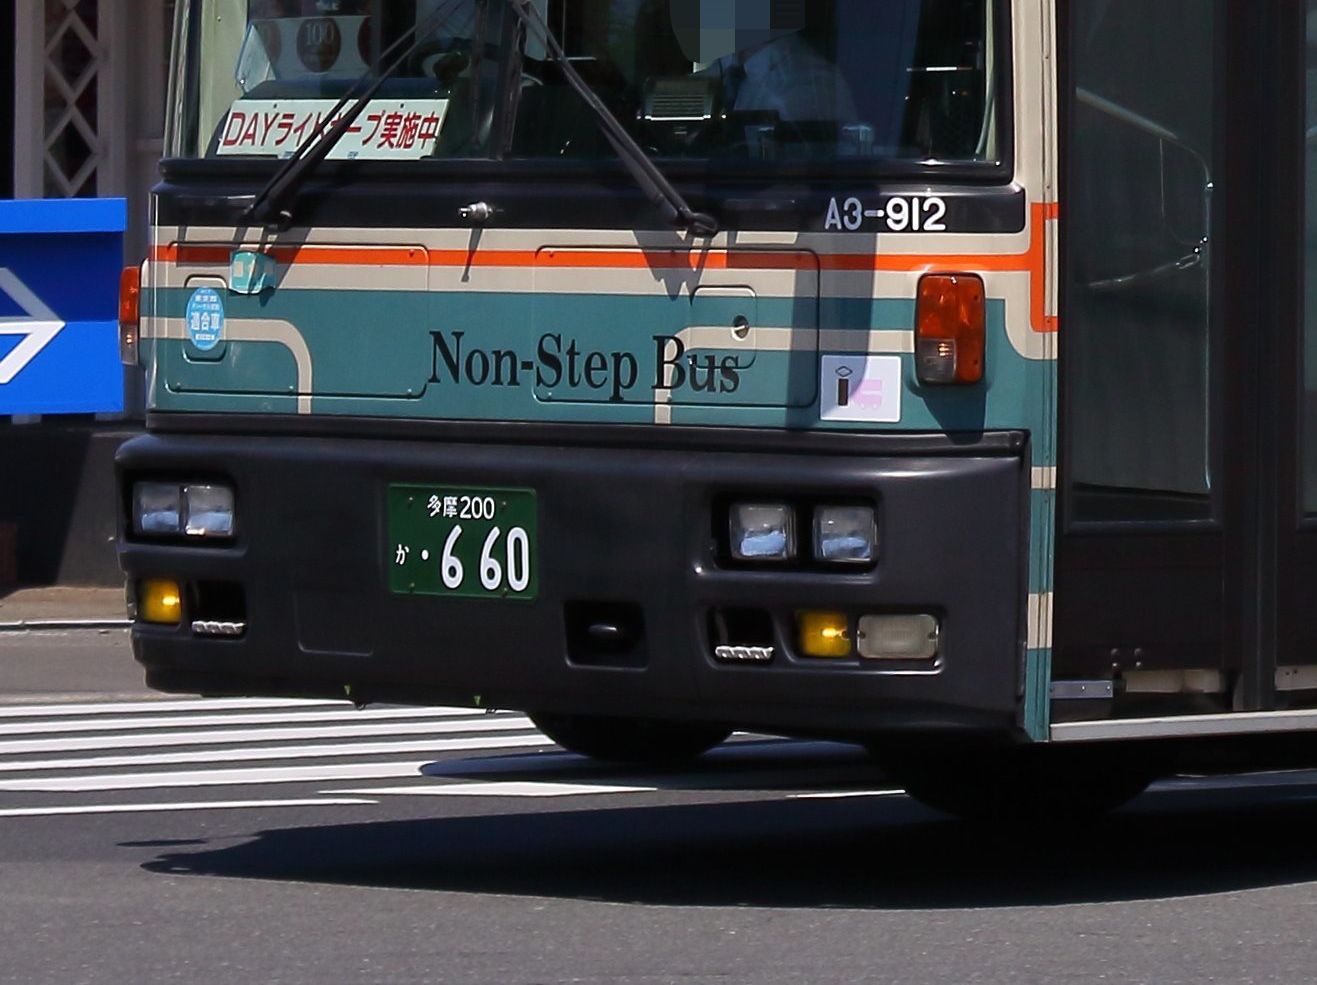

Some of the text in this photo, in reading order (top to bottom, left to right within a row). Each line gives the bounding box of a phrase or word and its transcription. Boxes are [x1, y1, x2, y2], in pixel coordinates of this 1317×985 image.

[825, 197, 947, 231] A3-912
[428, 329, 741, 402] Non-Step Bus
[395, 544, 410, 565] か
